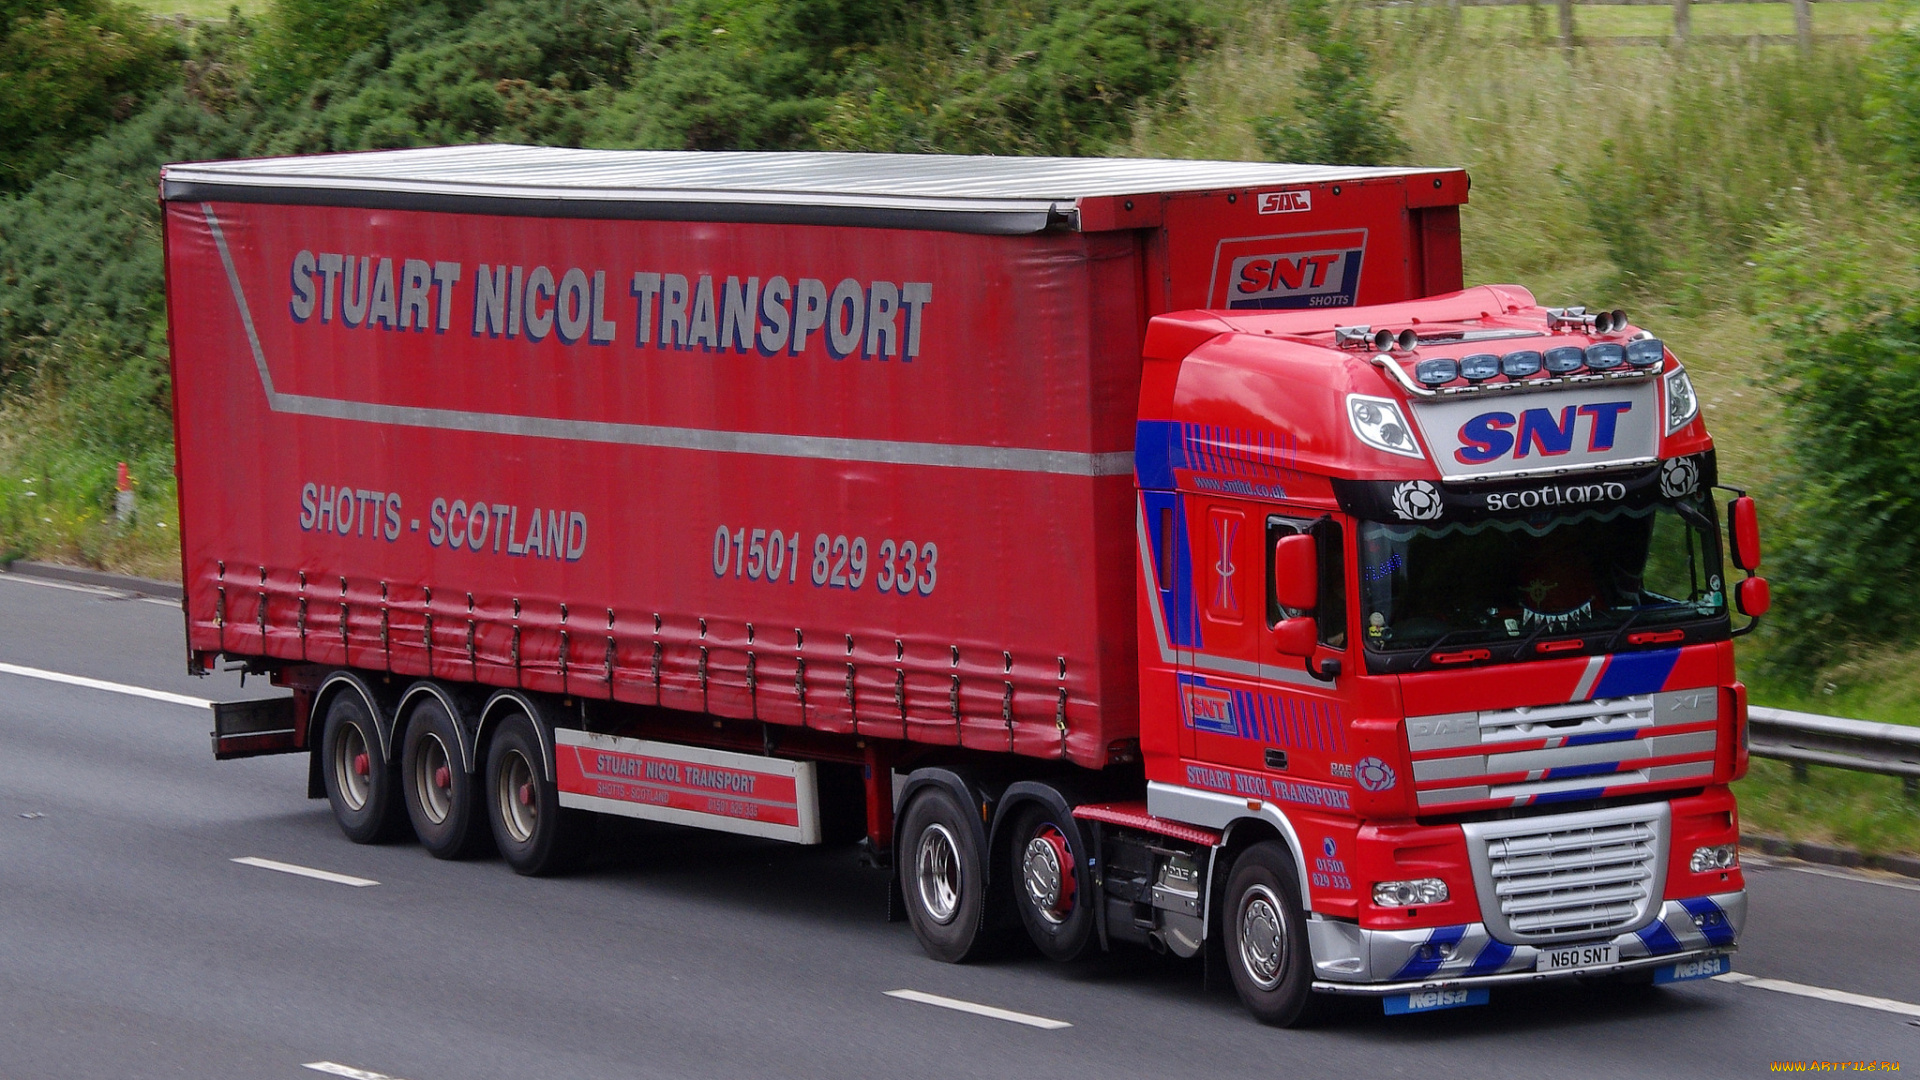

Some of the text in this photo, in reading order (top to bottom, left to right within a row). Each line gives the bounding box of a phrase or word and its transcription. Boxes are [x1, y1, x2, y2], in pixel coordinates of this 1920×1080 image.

[1237, 254, 1340, 294] SNT
[290, 250, 933, 362] STUART NICOL TRANSPORT
[1309, 295, 1349, 306] SHOTTS
[1454, 401, 1632, 465] SNT
[300, 482, 402, 543] SHOTTS
[429, 497, 588, 562] SCOTLAND
[713, 525, 938, 597] 01501 829 333
[1193, 697, 1225, 720] SNT
[1413, 718, 1476, 737] DAF
[597, 755, 755, 793] STUART NICOL TRANSPORT
[597, 782, 625, 798] SHOTTS
[631, 788, 669, 804] SCOTLAND
[1187, 765, 1350, 809] STUART NICOL TRANSPORT
[1316, 857, 1345, 873] 01501
[1313, 872, 1351, 890] 829 333
[1551, 947, 1611, 967] N60 SNT
[1408, 990, 1468, 1009] Kelsa
